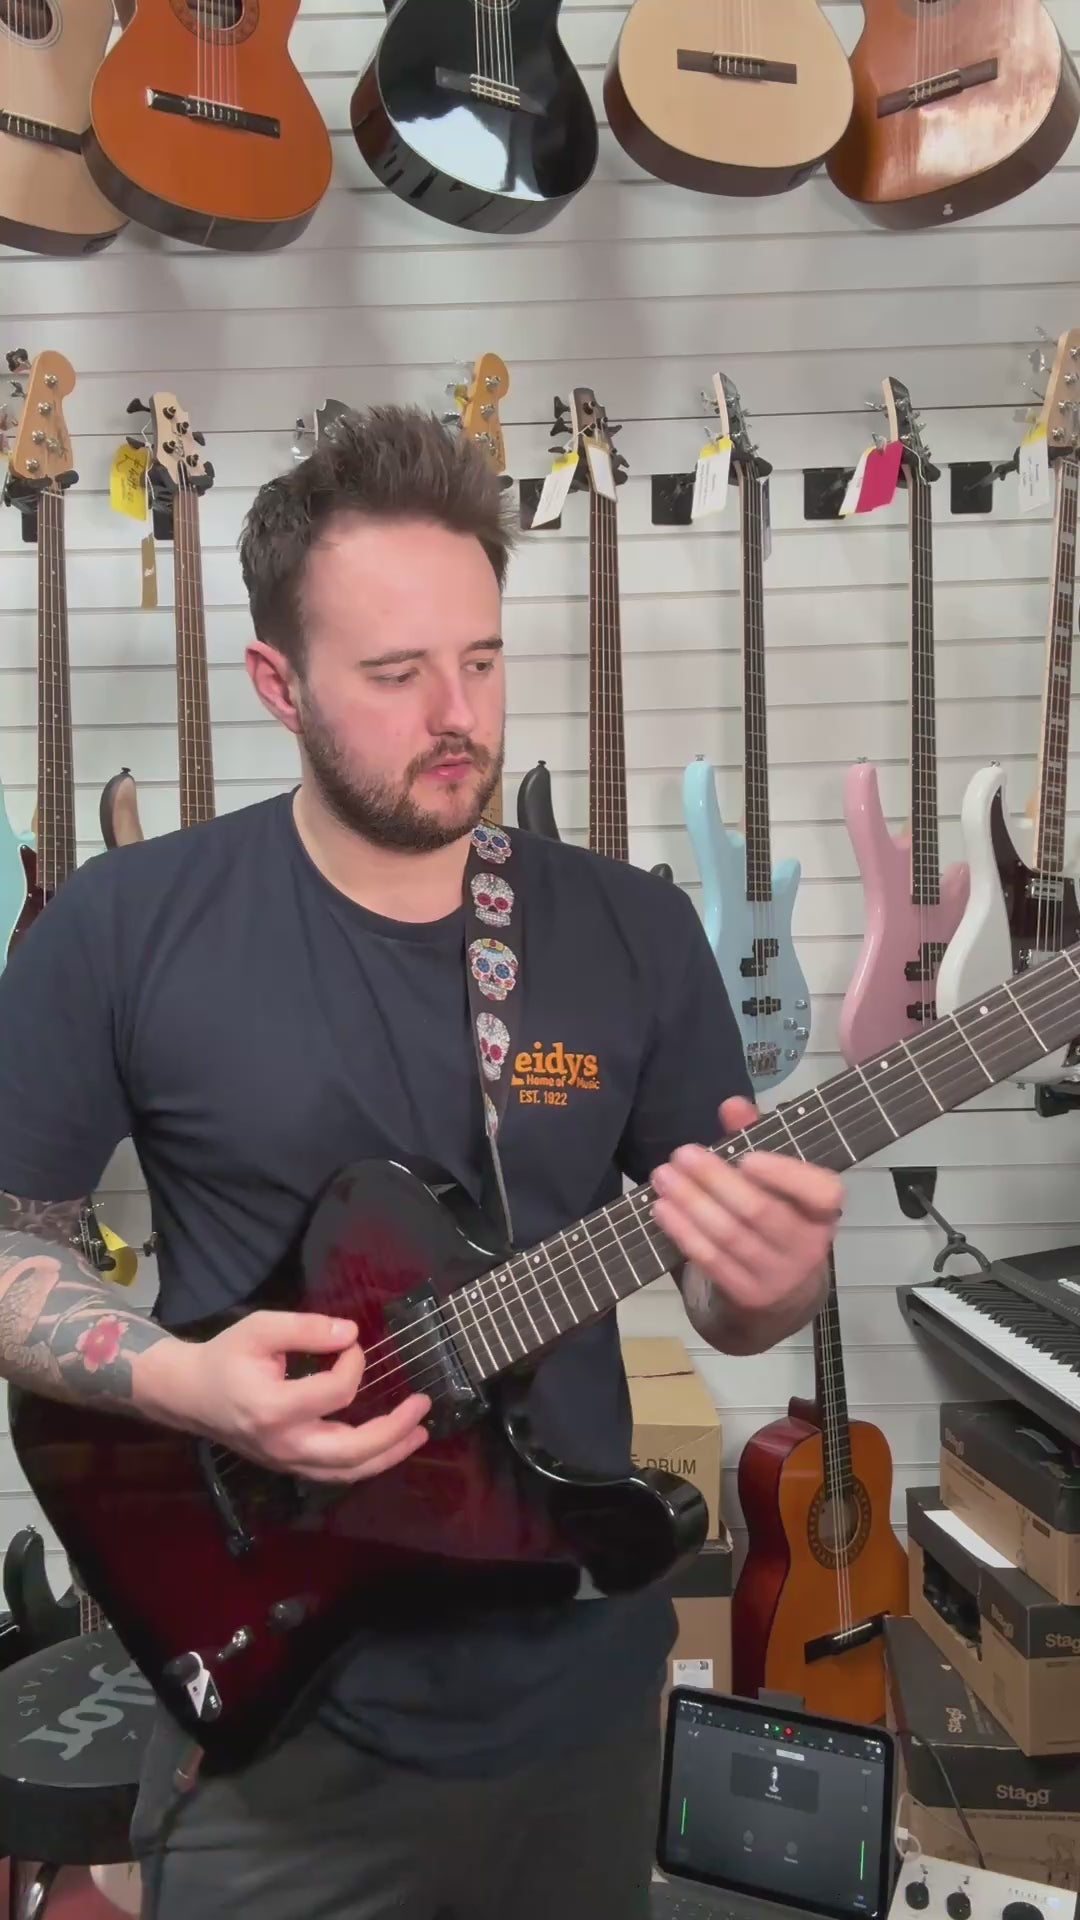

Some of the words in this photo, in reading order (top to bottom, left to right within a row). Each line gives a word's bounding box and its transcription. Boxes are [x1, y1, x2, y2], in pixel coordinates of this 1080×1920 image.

[511, 1041, 599, 1086] eidys
[556, 1076, 566, 1088] of
[519, 1090, 541, 1104] EST.
[646, 1458, 697, 1475] DRUM
[1045, 1633, 1080, 1654] Stag
[996, 1784, 1051, 1808] Stagg
